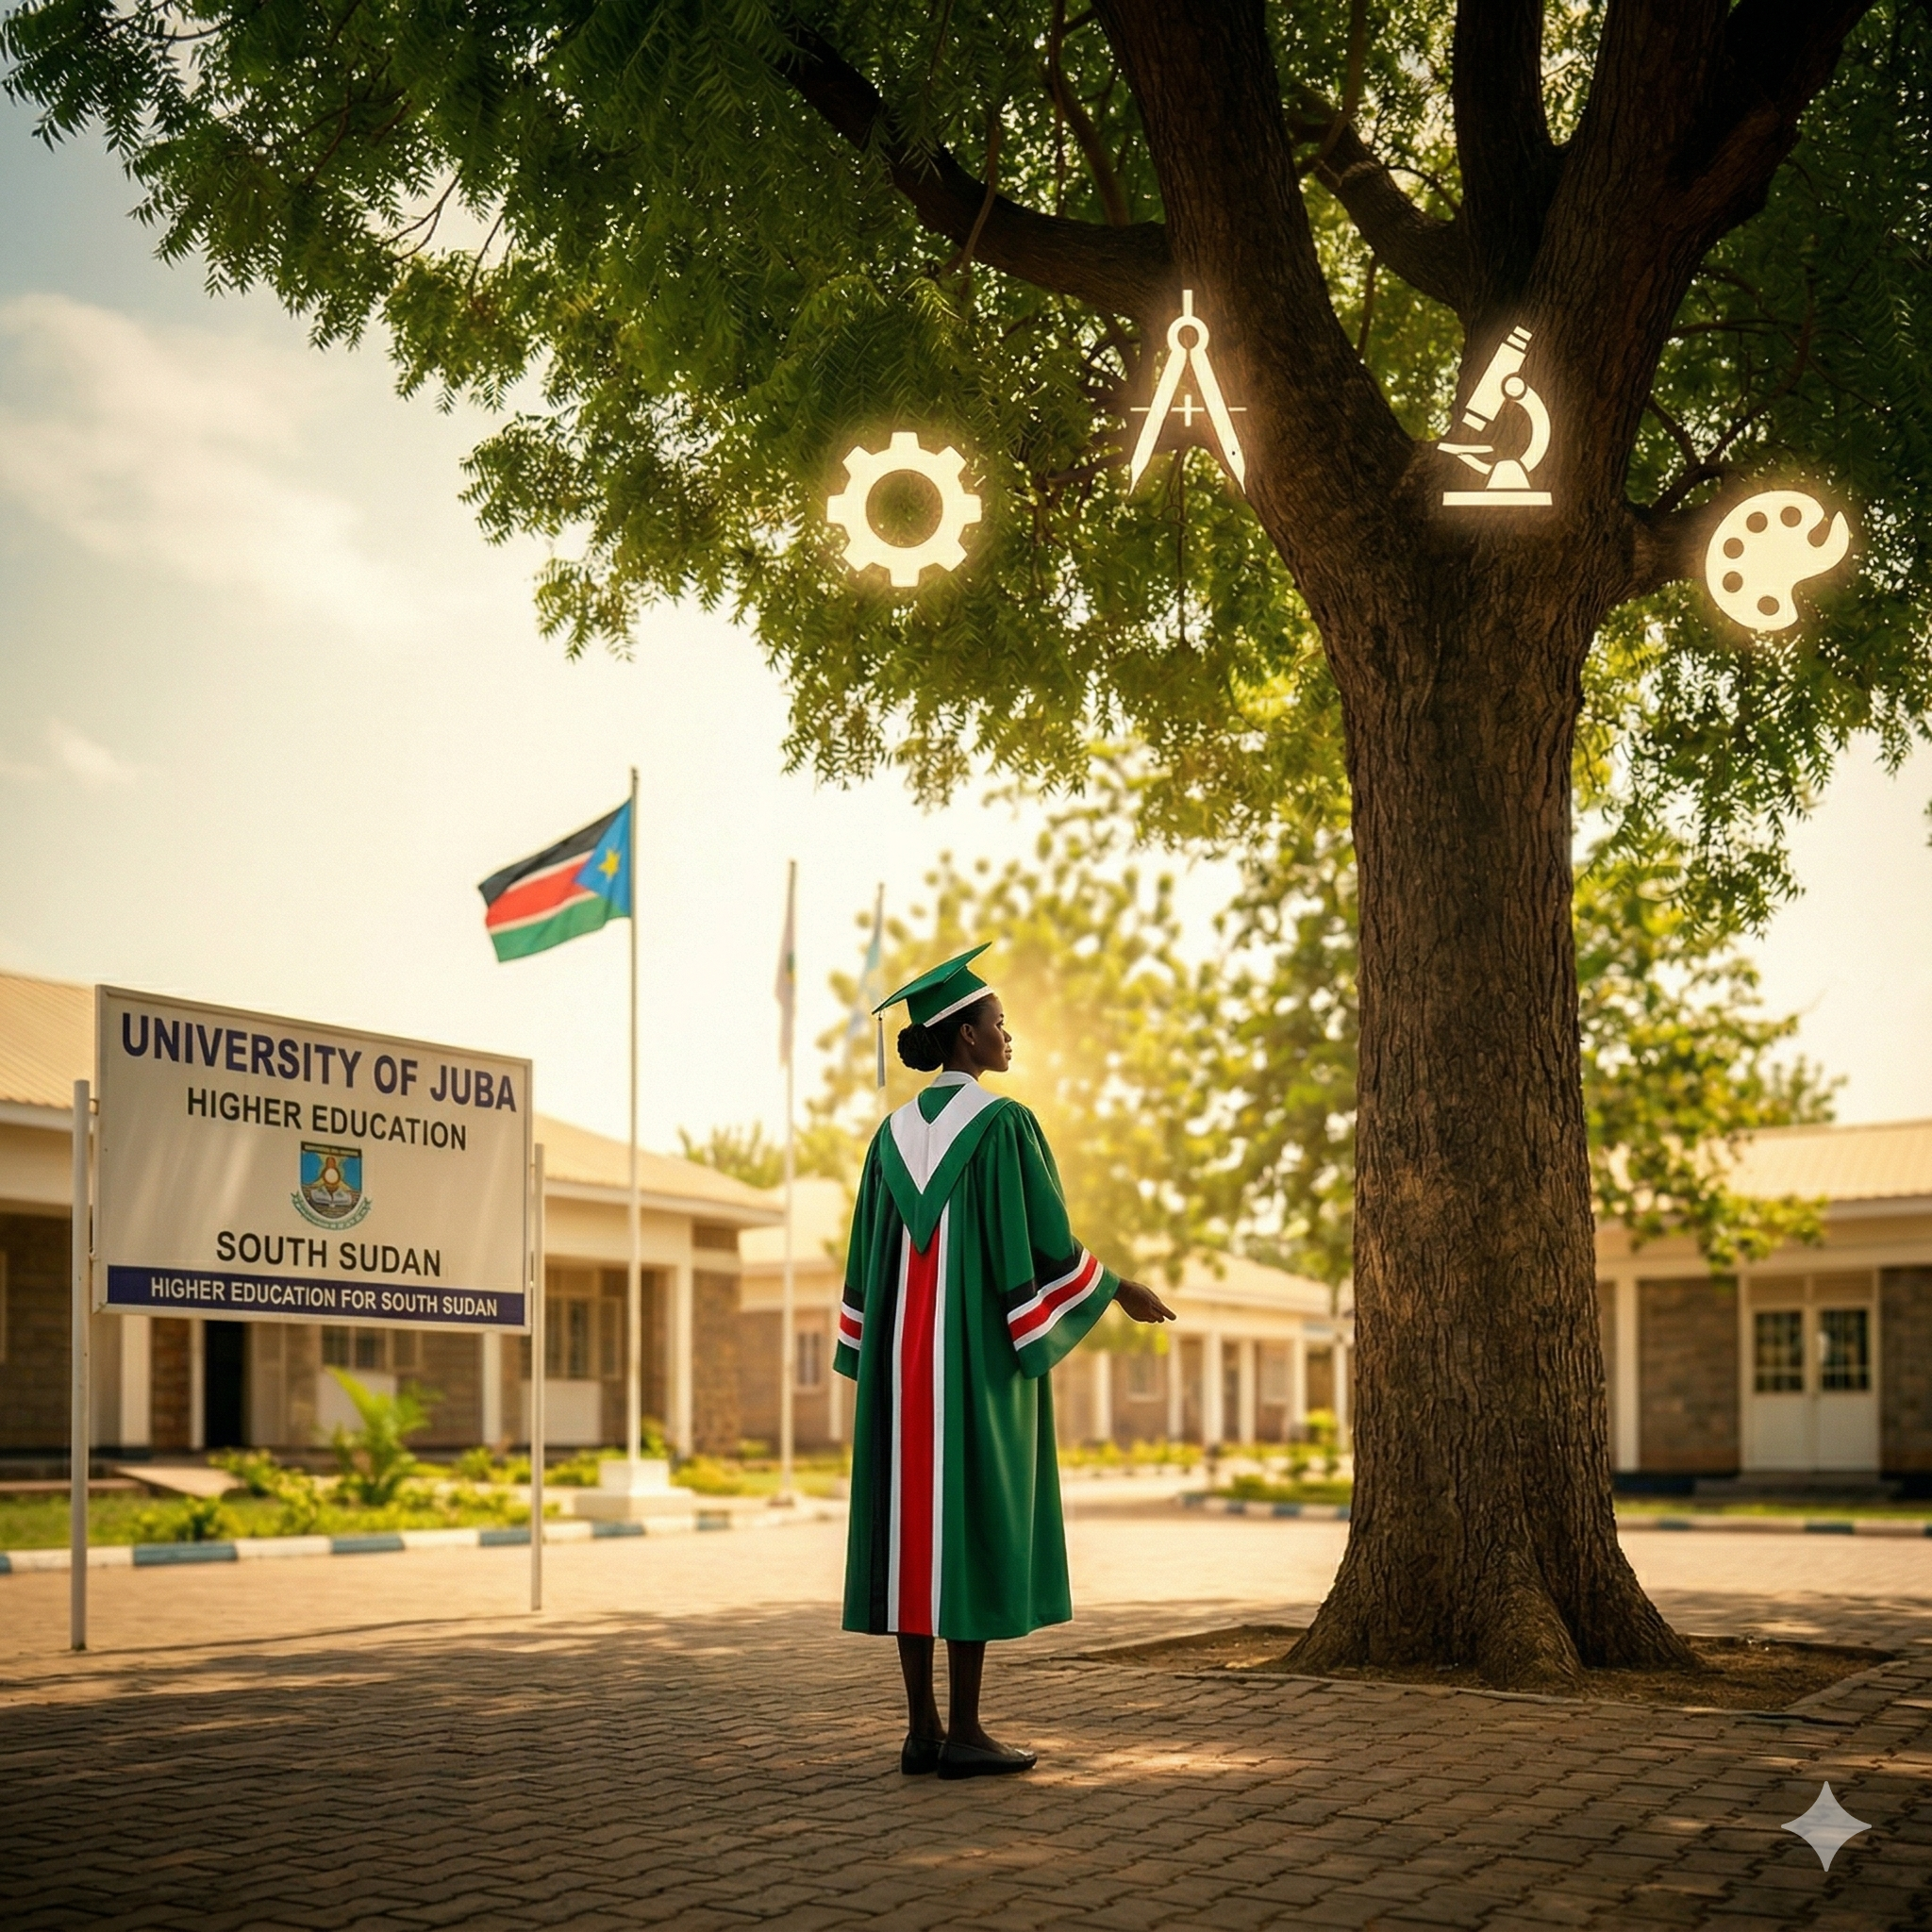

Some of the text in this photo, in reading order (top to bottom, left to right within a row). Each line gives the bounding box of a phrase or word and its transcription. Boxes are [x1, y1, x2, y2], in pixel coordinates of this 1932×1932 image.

[122, 1011, 517, 1112] UNIVERSITY OF JUBA
[188, 1087, 467, 1151] HIGHER EDUCATION
[216, 1230, 441, 1276] SOUTH SUDAN
[151, 1276, 497, 1317] HIGHER EDUCATION FOR SOUTH SUDAN
